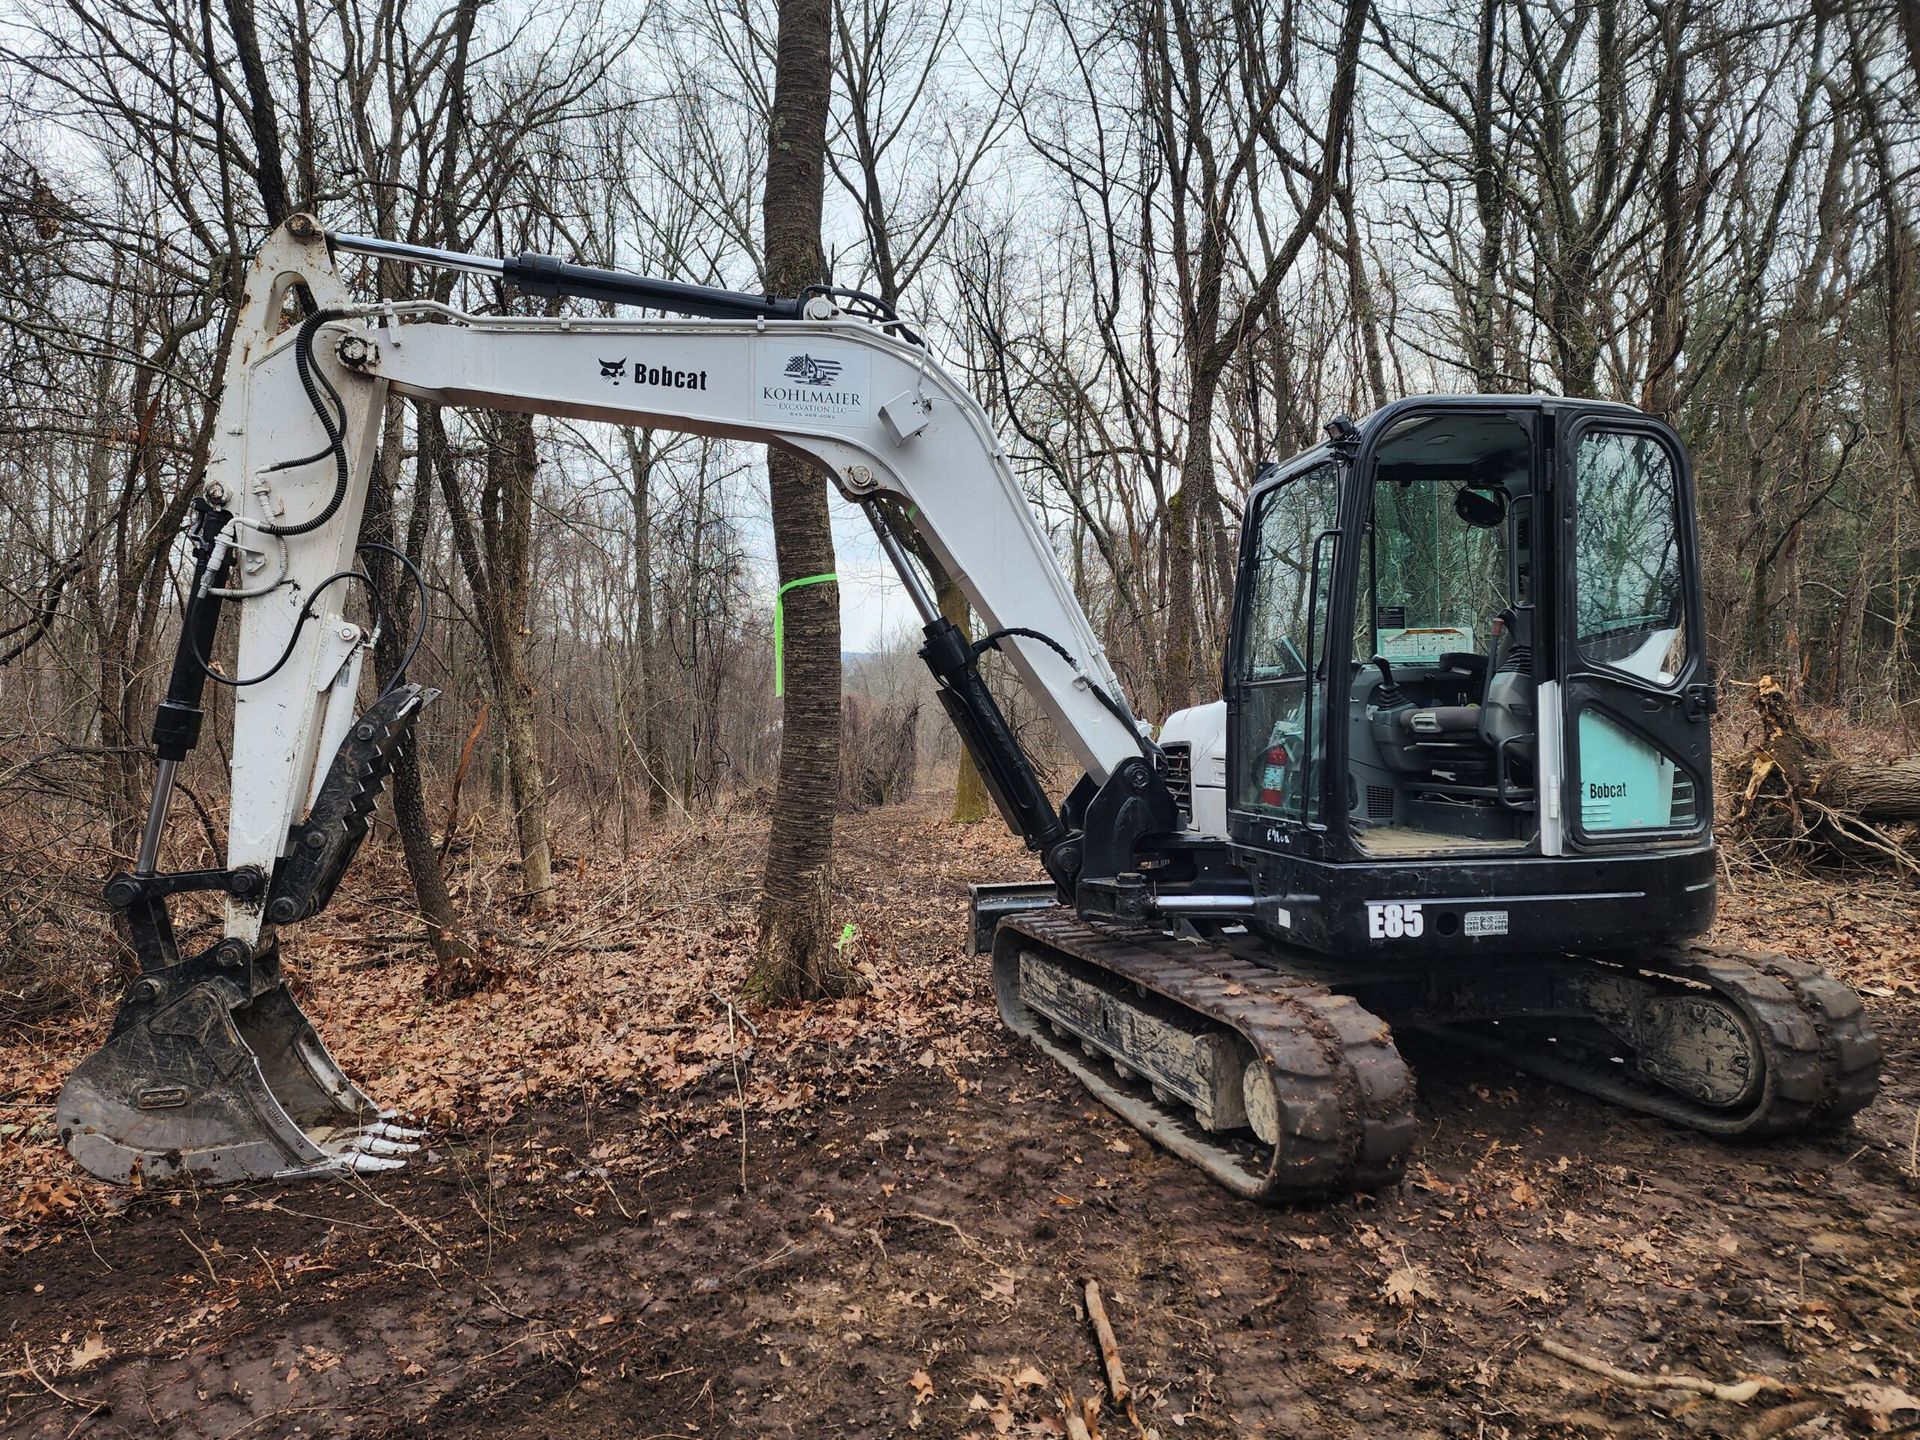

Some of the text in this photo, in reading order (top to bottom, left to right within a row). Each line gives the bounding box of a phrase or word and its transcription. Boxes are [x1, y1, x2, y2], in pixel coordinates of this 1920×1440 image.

[634, 363, 707, 391] Bobcat
[763, 387, 861, 406] KOHLMAIER
[779, 403, 847, 414] EXCAVATION LLC
[1590, 782, 1627, 799] Bobcat
[1368, 904, 1424, 939] E85
